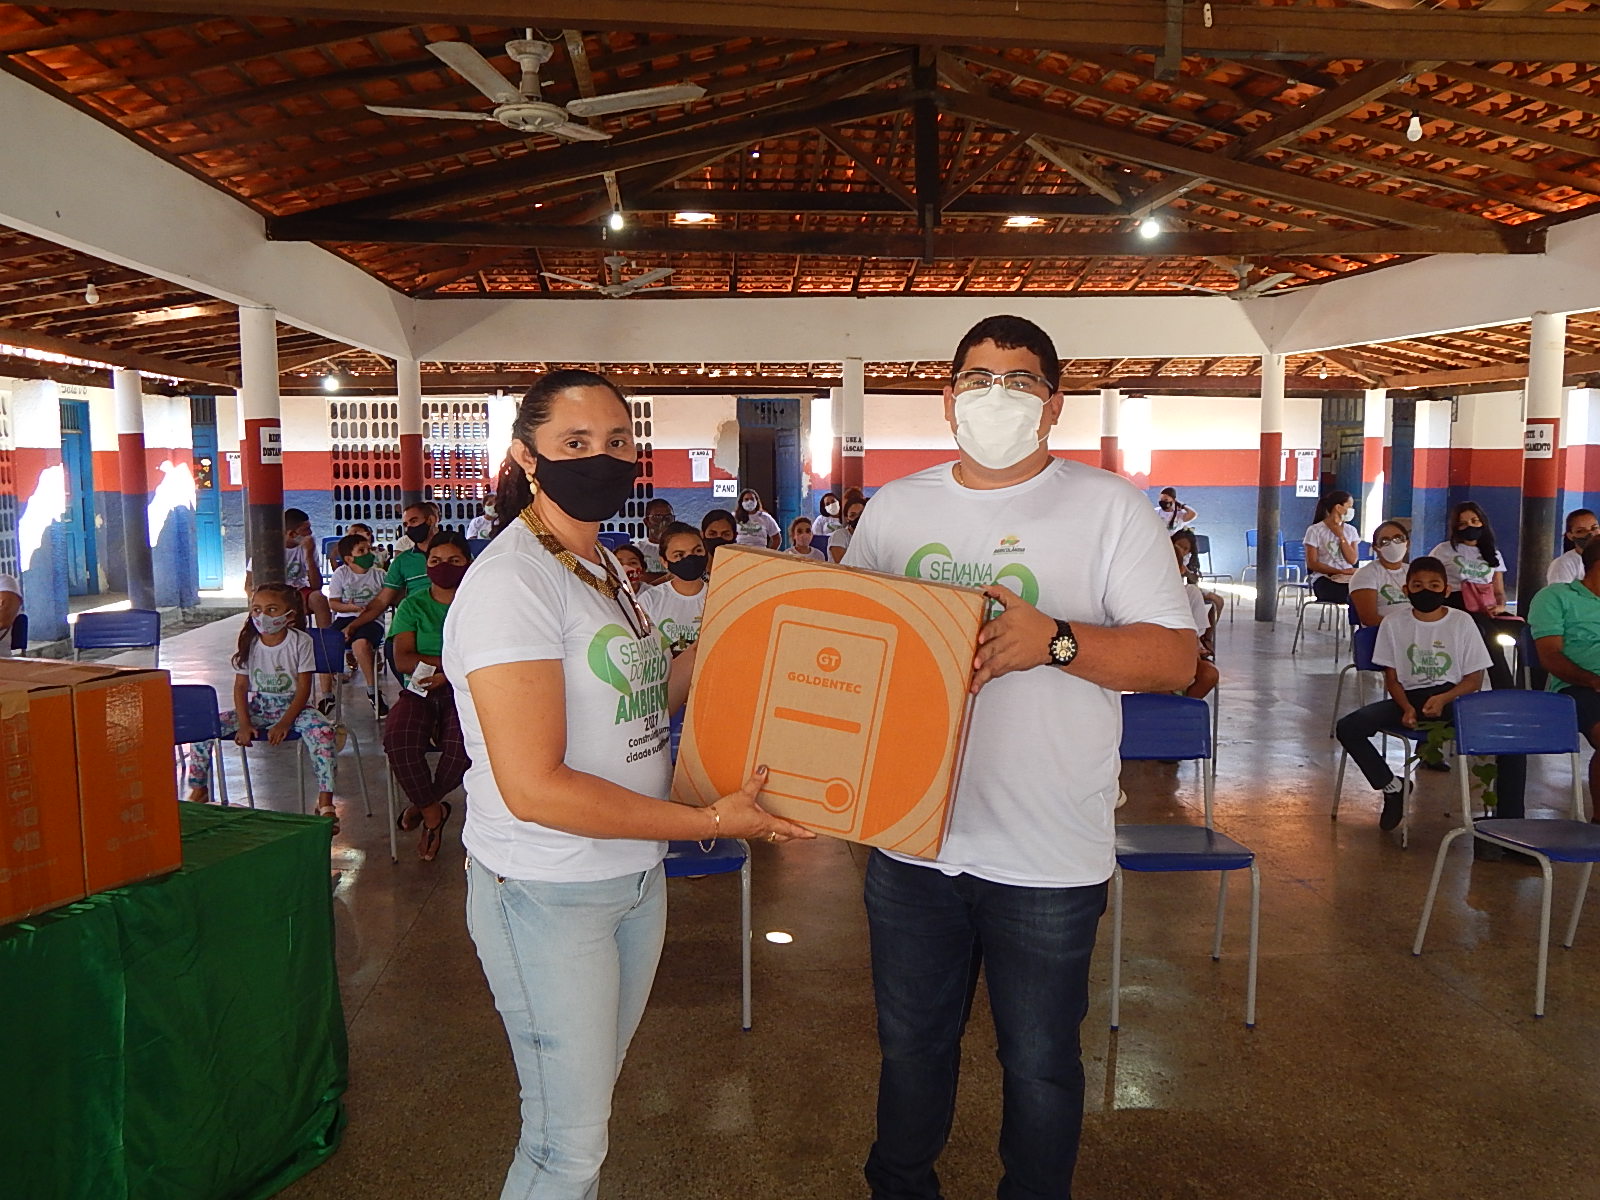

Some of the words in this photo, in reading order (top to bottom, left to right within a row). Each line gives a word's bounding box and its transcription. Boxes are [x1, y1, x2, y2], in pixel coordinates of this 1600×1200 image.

[715, 484, 721, 493] 2º
[721, 484, 736, 493] ANO
[1304, 484, 1317, 493] ANO
[929, 560, 994, 582] SEMANA
[666, 623, 695, 633] SEMANA
[619, 636, 662, 666] SEMANA
[819, 653, 839, 668] GT
[629, 661, 643, 682] DO
[640, 656, 668, 686] MEIO
[786, 671, 863, 695] GOLDENTEC
[625, 748, 652, 764] cidade
